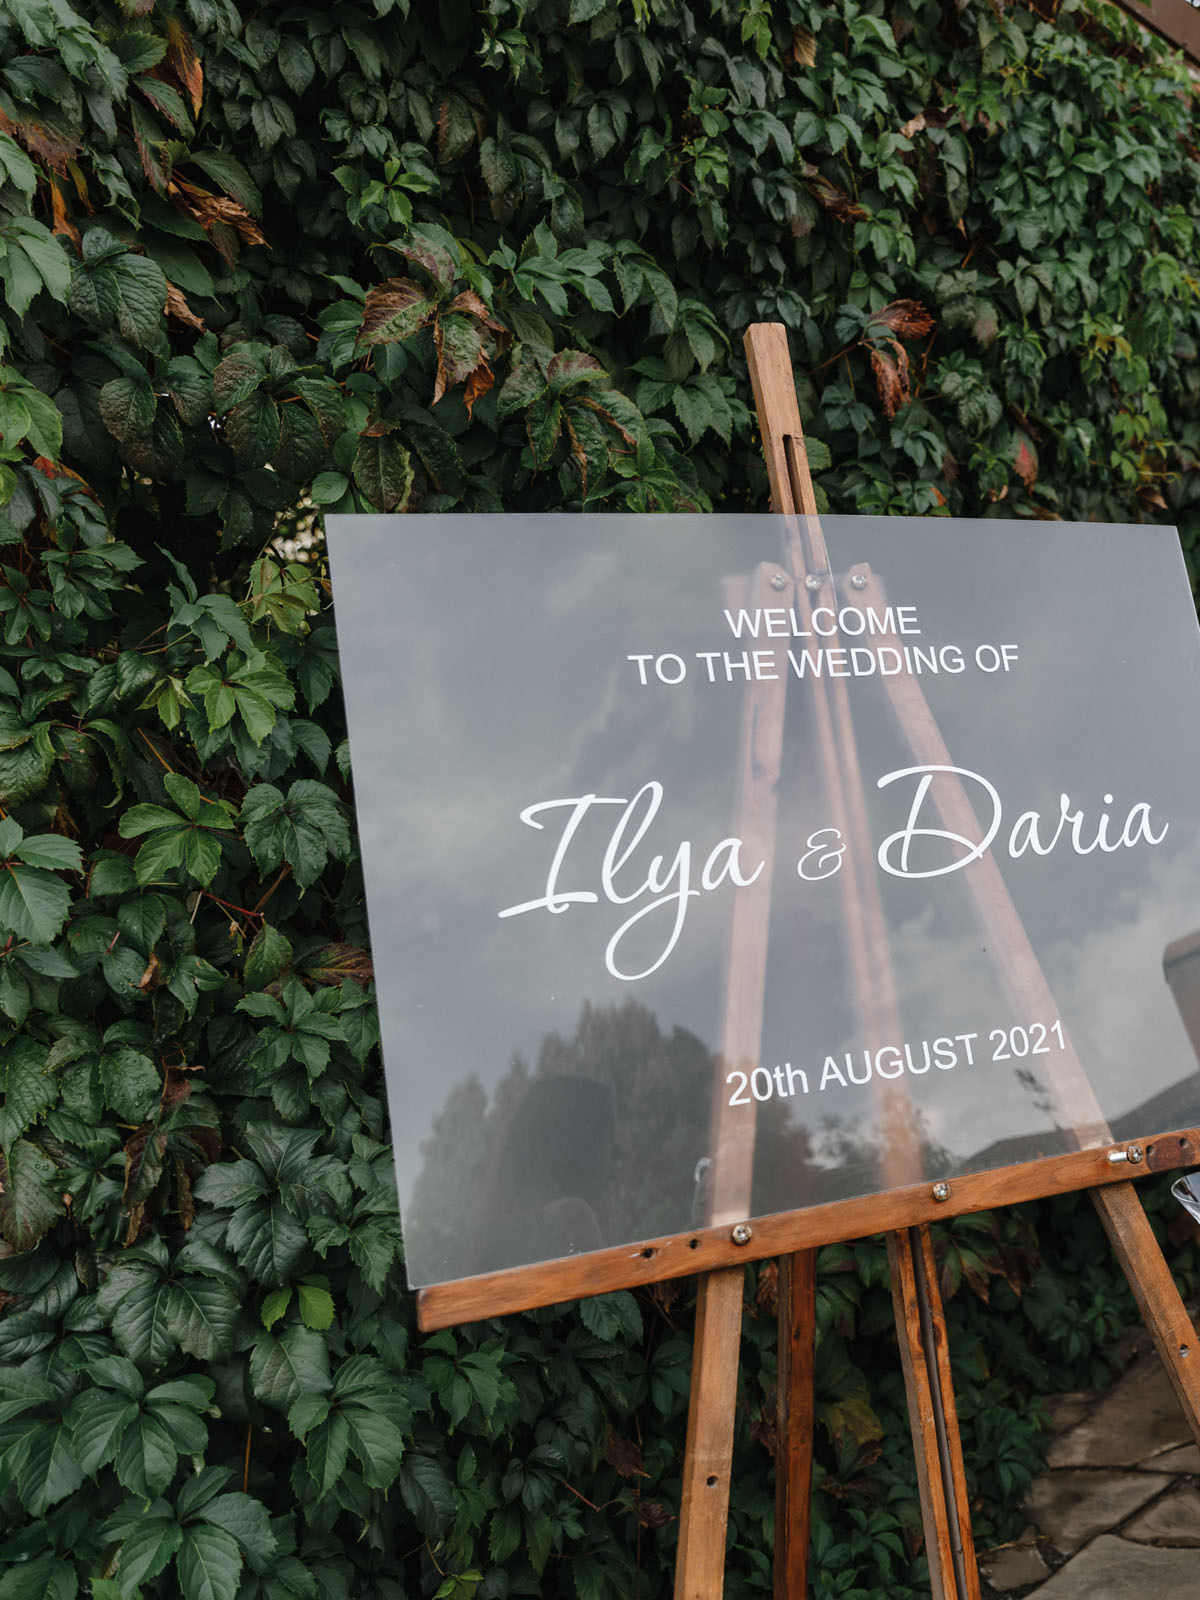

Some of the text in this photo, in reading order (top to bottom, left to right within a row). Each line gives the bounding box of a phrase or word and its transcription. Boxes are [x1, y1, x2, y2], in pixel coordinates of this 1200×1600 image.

[723, 606, 922, 639] WELCOME
[627, 643, 1020, 686] TO THE WEDDING OF
[498, 764, 1169, 981] Ilya & Daria
[726, 1018, 1067, 1107] 20th AUGUST 2021
